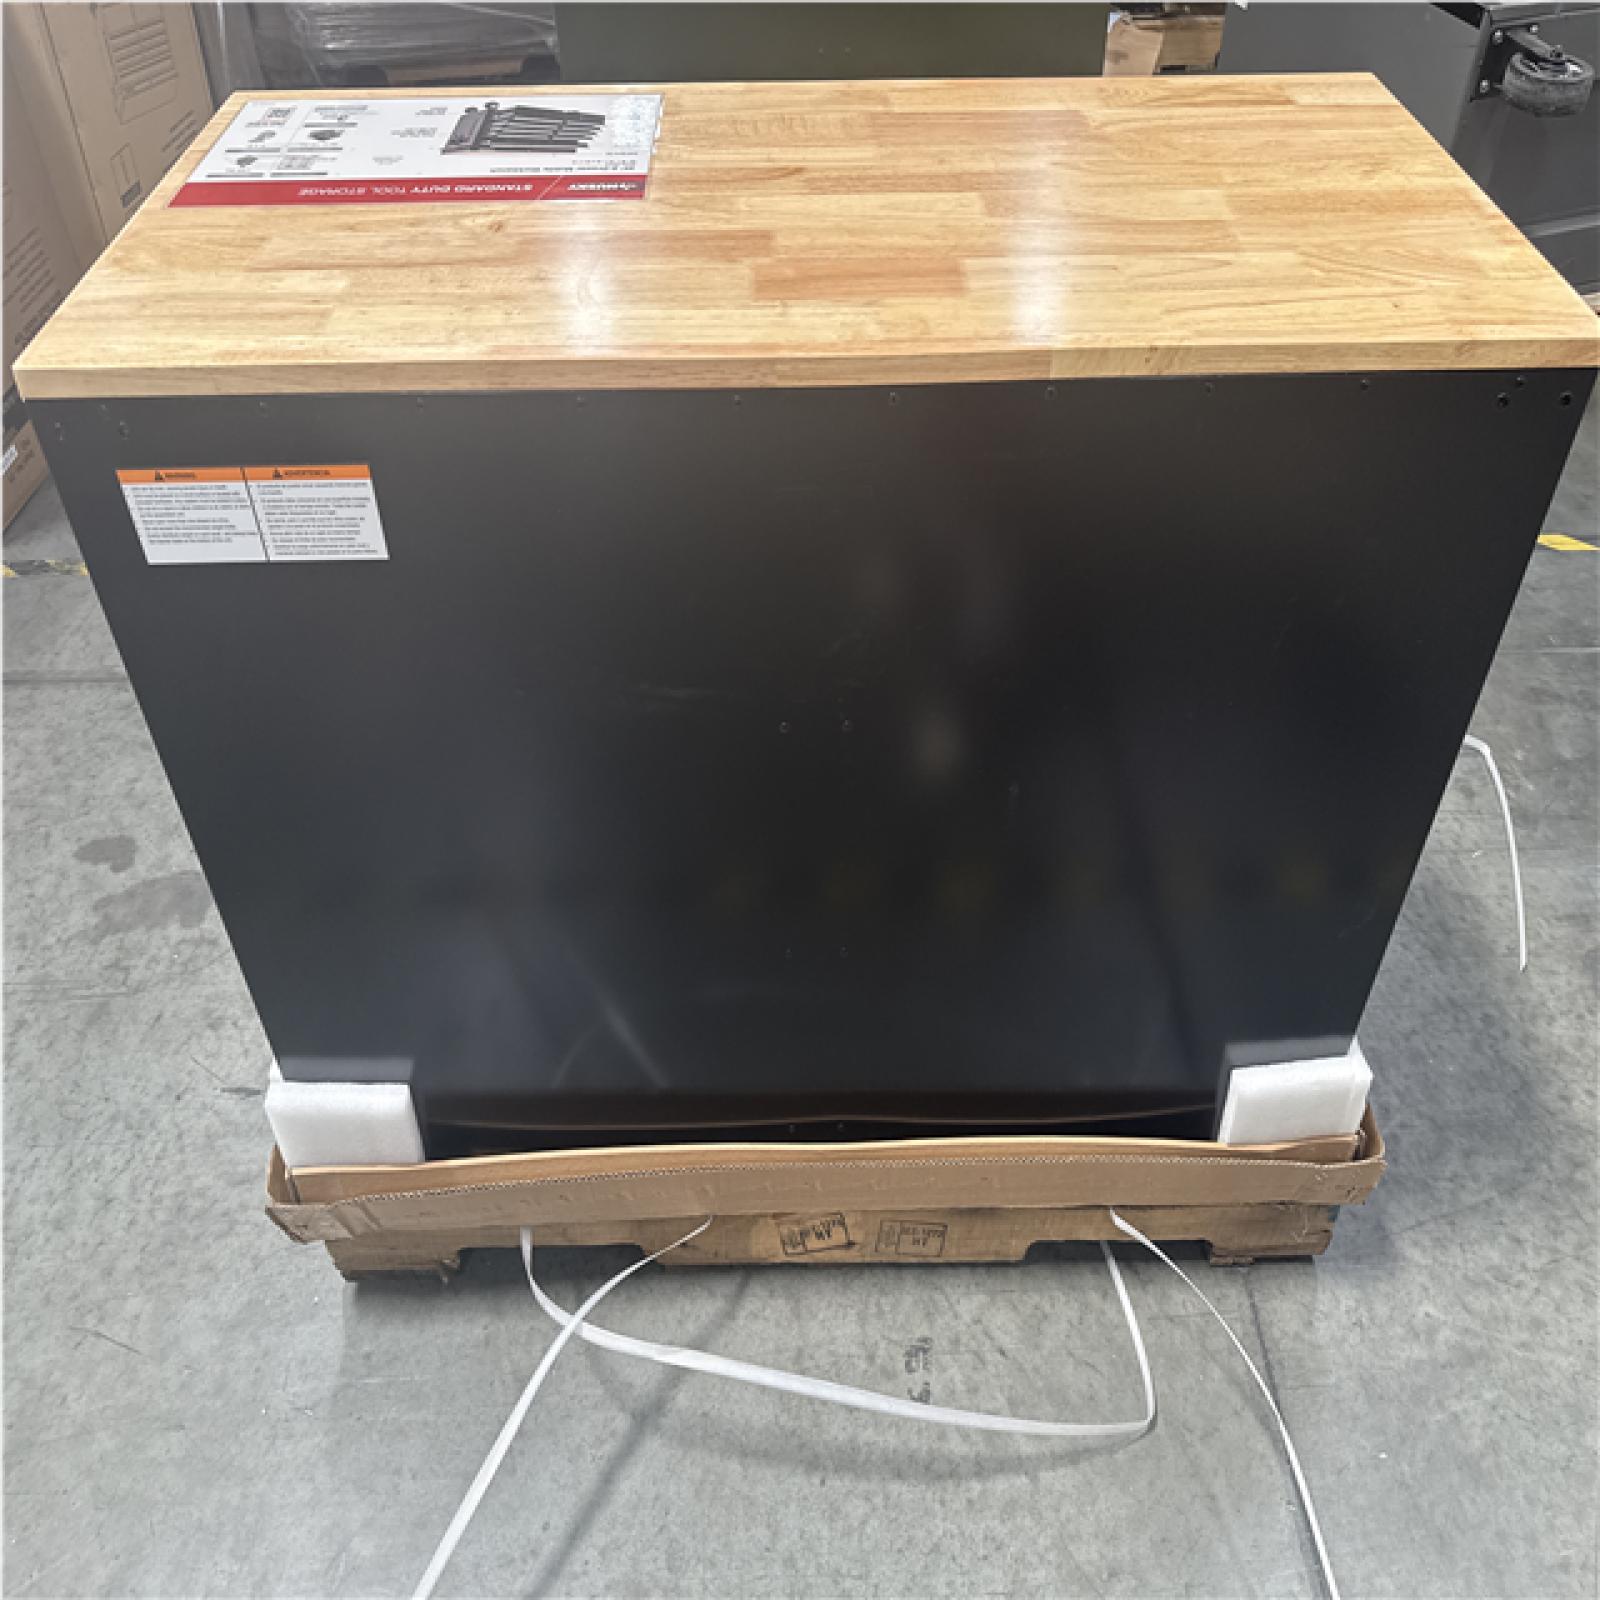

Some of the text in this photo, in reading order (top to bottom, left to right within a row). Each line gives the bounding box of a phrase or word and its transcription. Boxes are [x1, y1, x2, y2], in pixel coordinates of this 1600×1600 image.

[297, 183, 533, 196] STANDARD DUTY TOOL STORAGE
[568, 182, 618, 190] HUSKY
